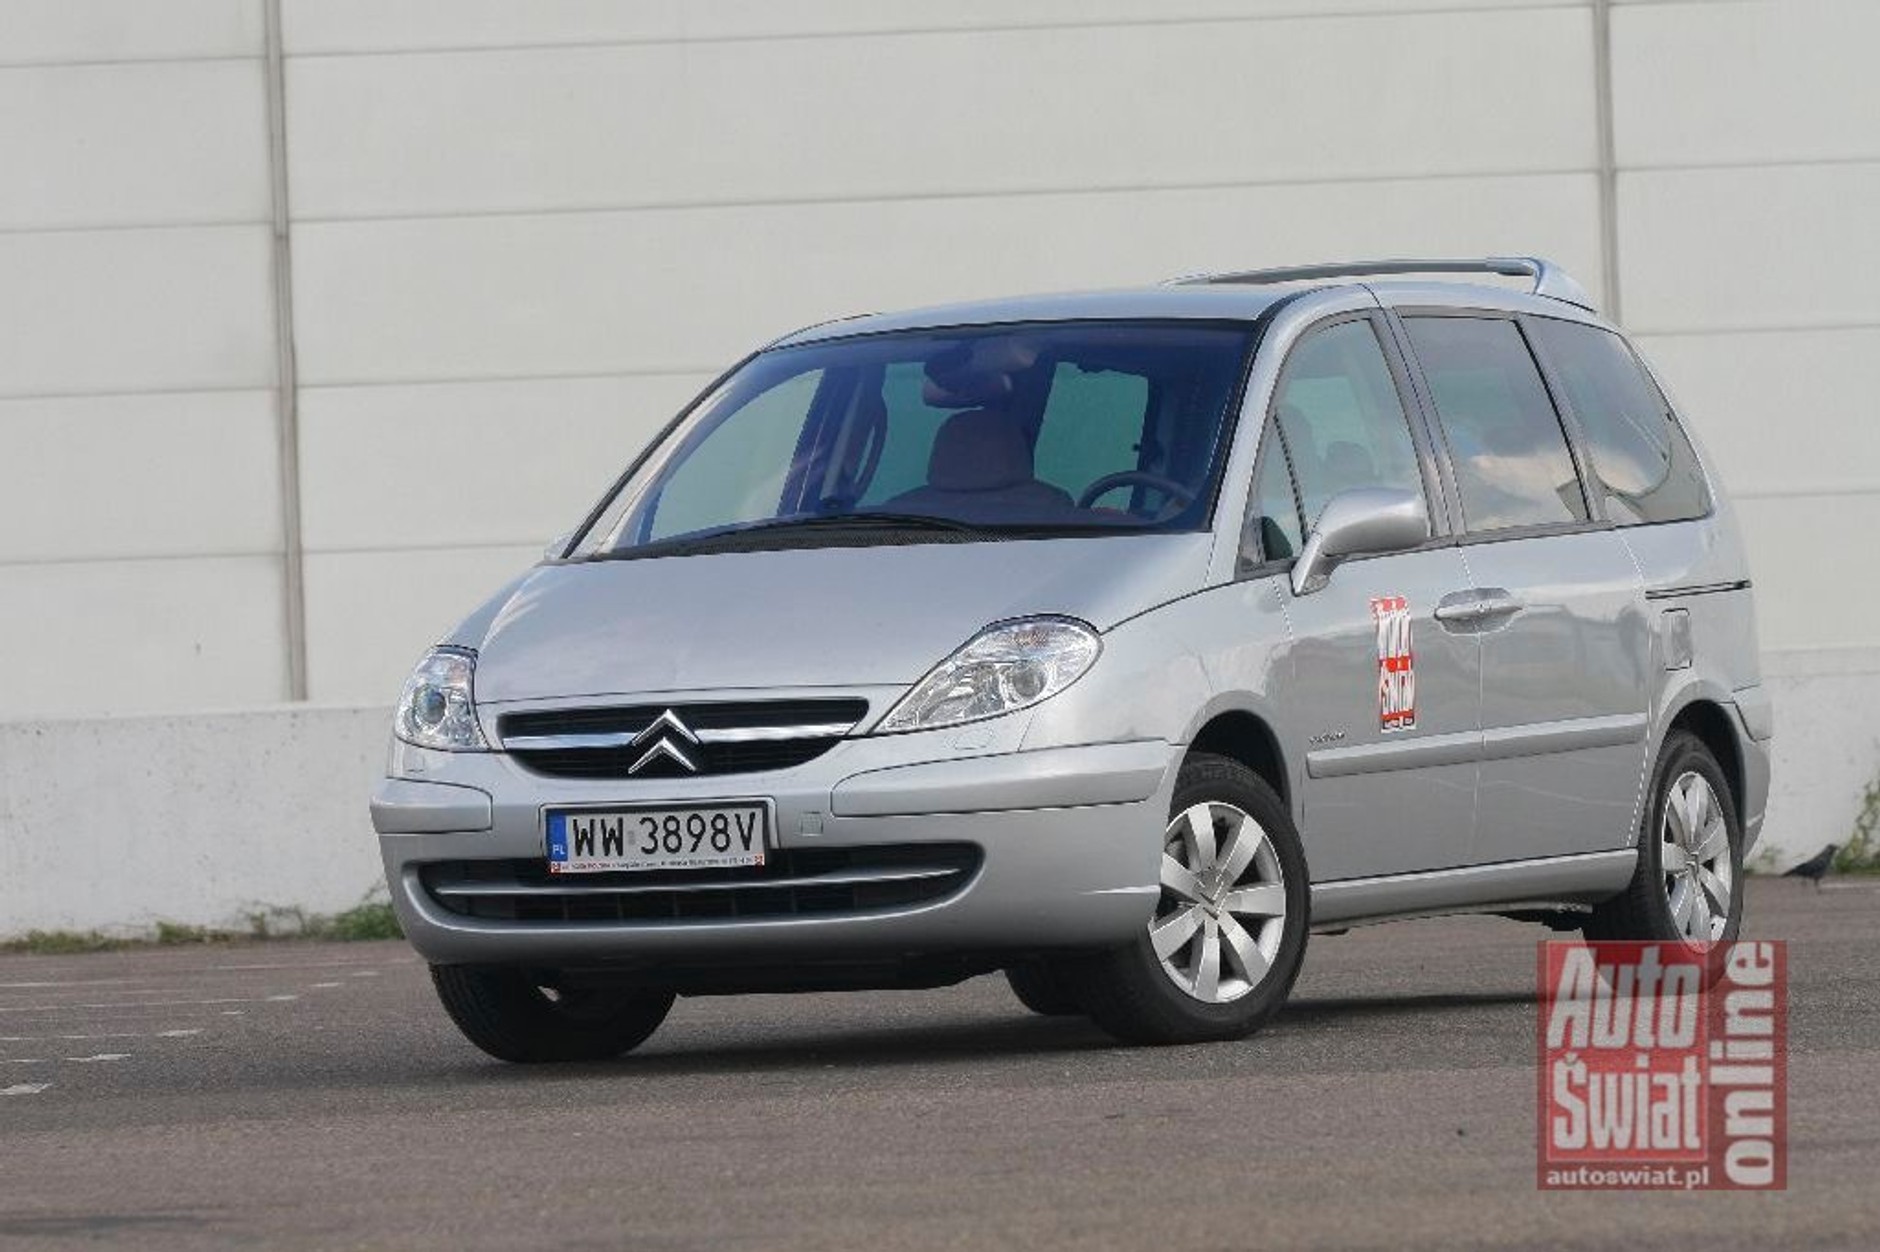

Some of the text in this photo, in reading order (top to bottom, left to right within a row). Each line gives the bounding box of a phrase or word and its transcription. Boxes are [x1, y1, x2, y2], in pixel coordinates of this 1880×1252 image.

[573, 811, 756, 857] WW 3898V
[552, 846, 566, 855] PL
